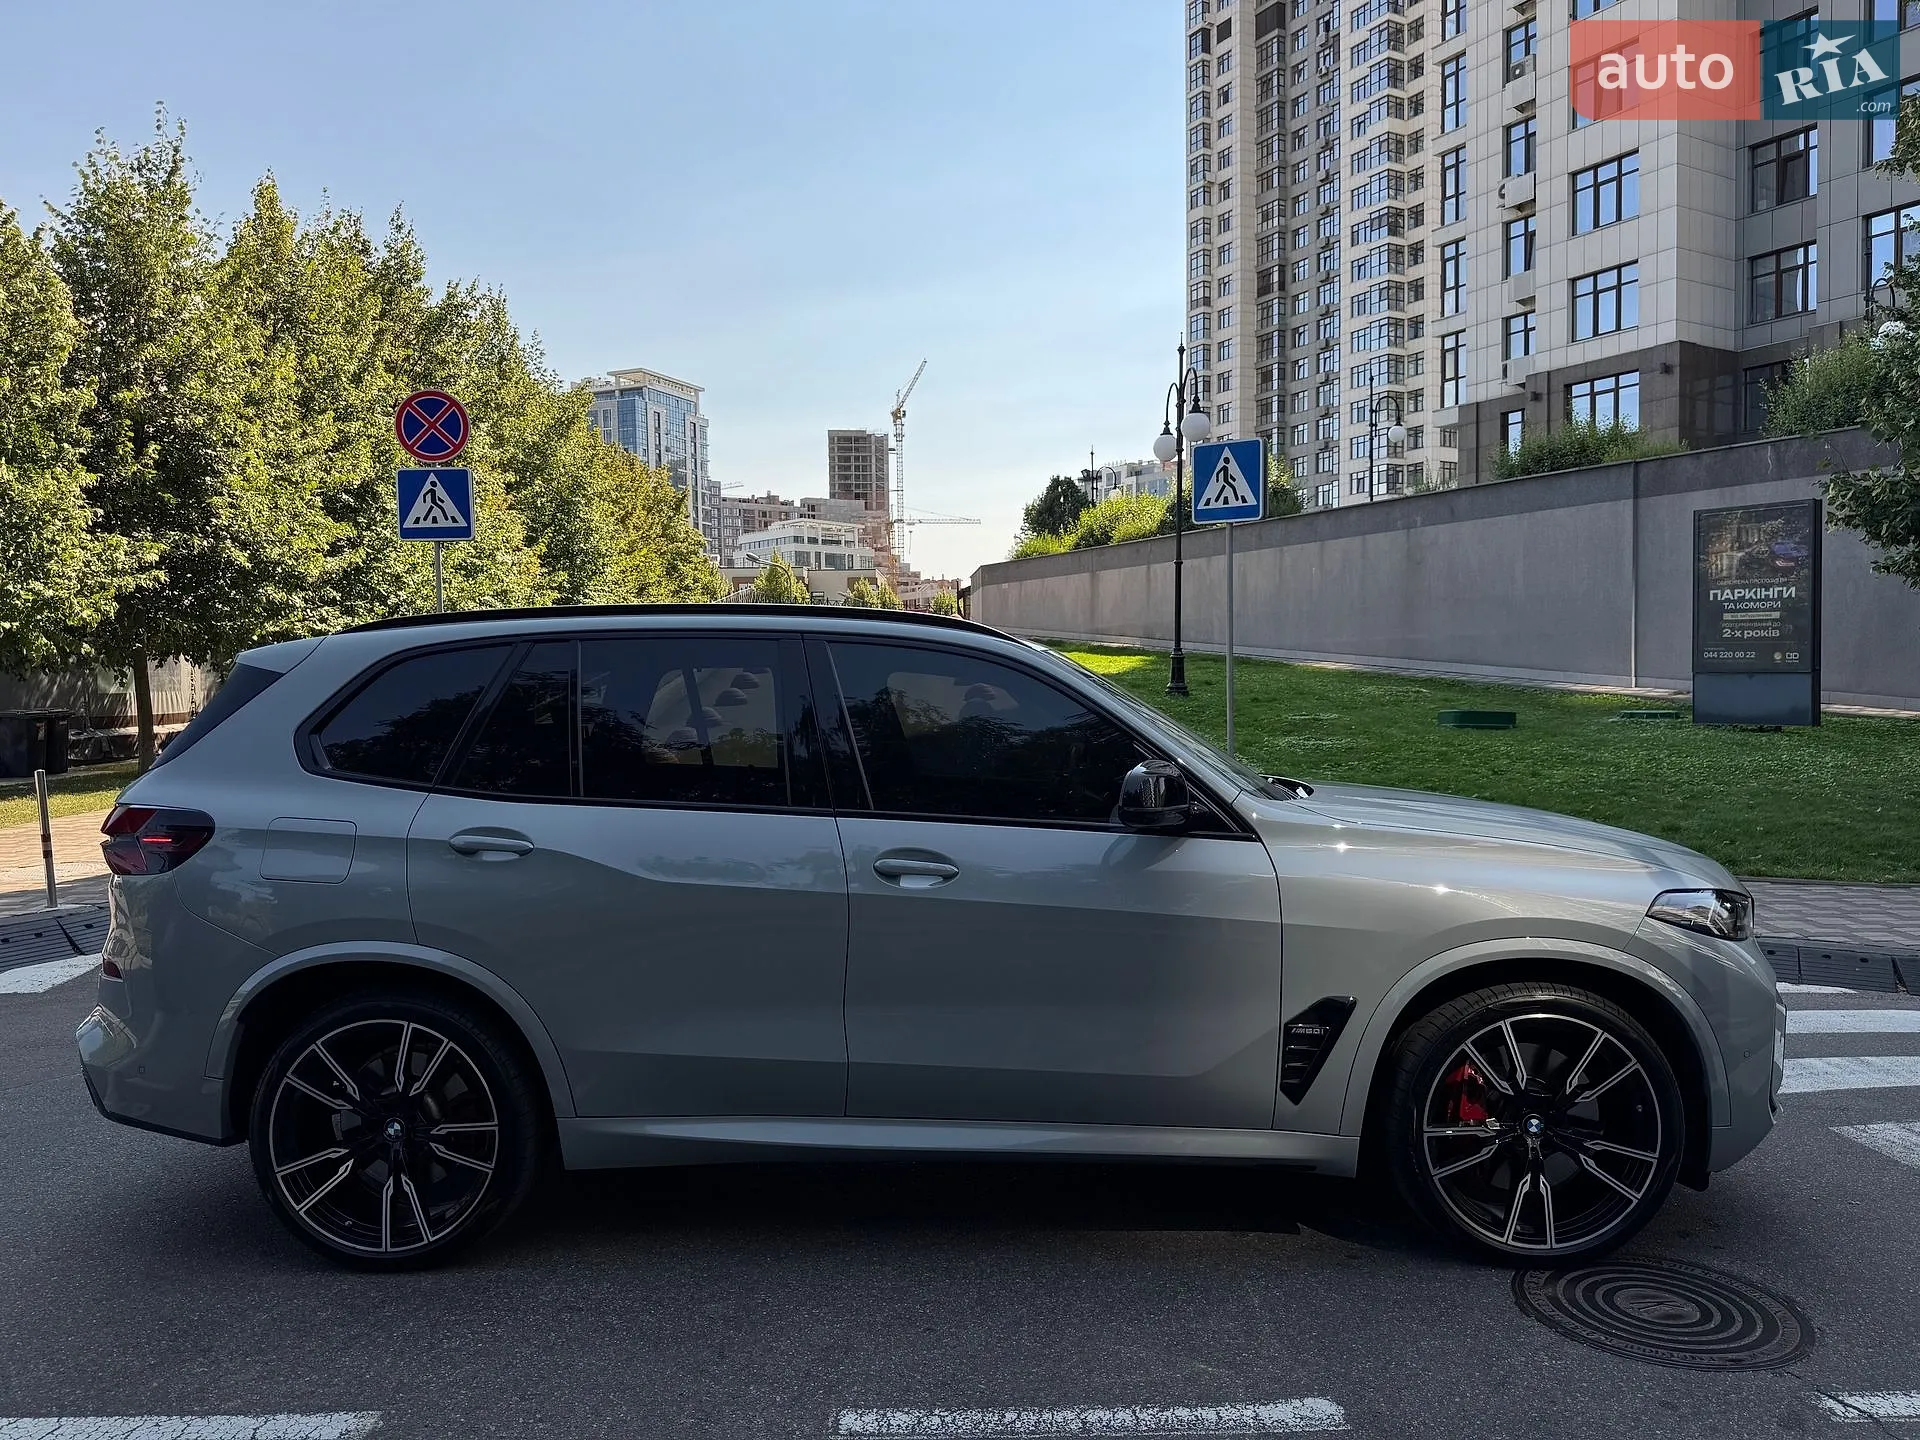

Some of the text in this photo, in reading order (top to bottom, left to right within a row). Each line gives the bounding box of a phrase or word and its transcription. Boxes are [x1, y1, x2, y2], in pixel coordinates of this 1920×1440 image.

[1709, 586, 1796, 601] ПАРКІНГИ
[1723, 600, 1781, 610] ТА КОМОРИ
[1744, 627, 1780, 639] років
